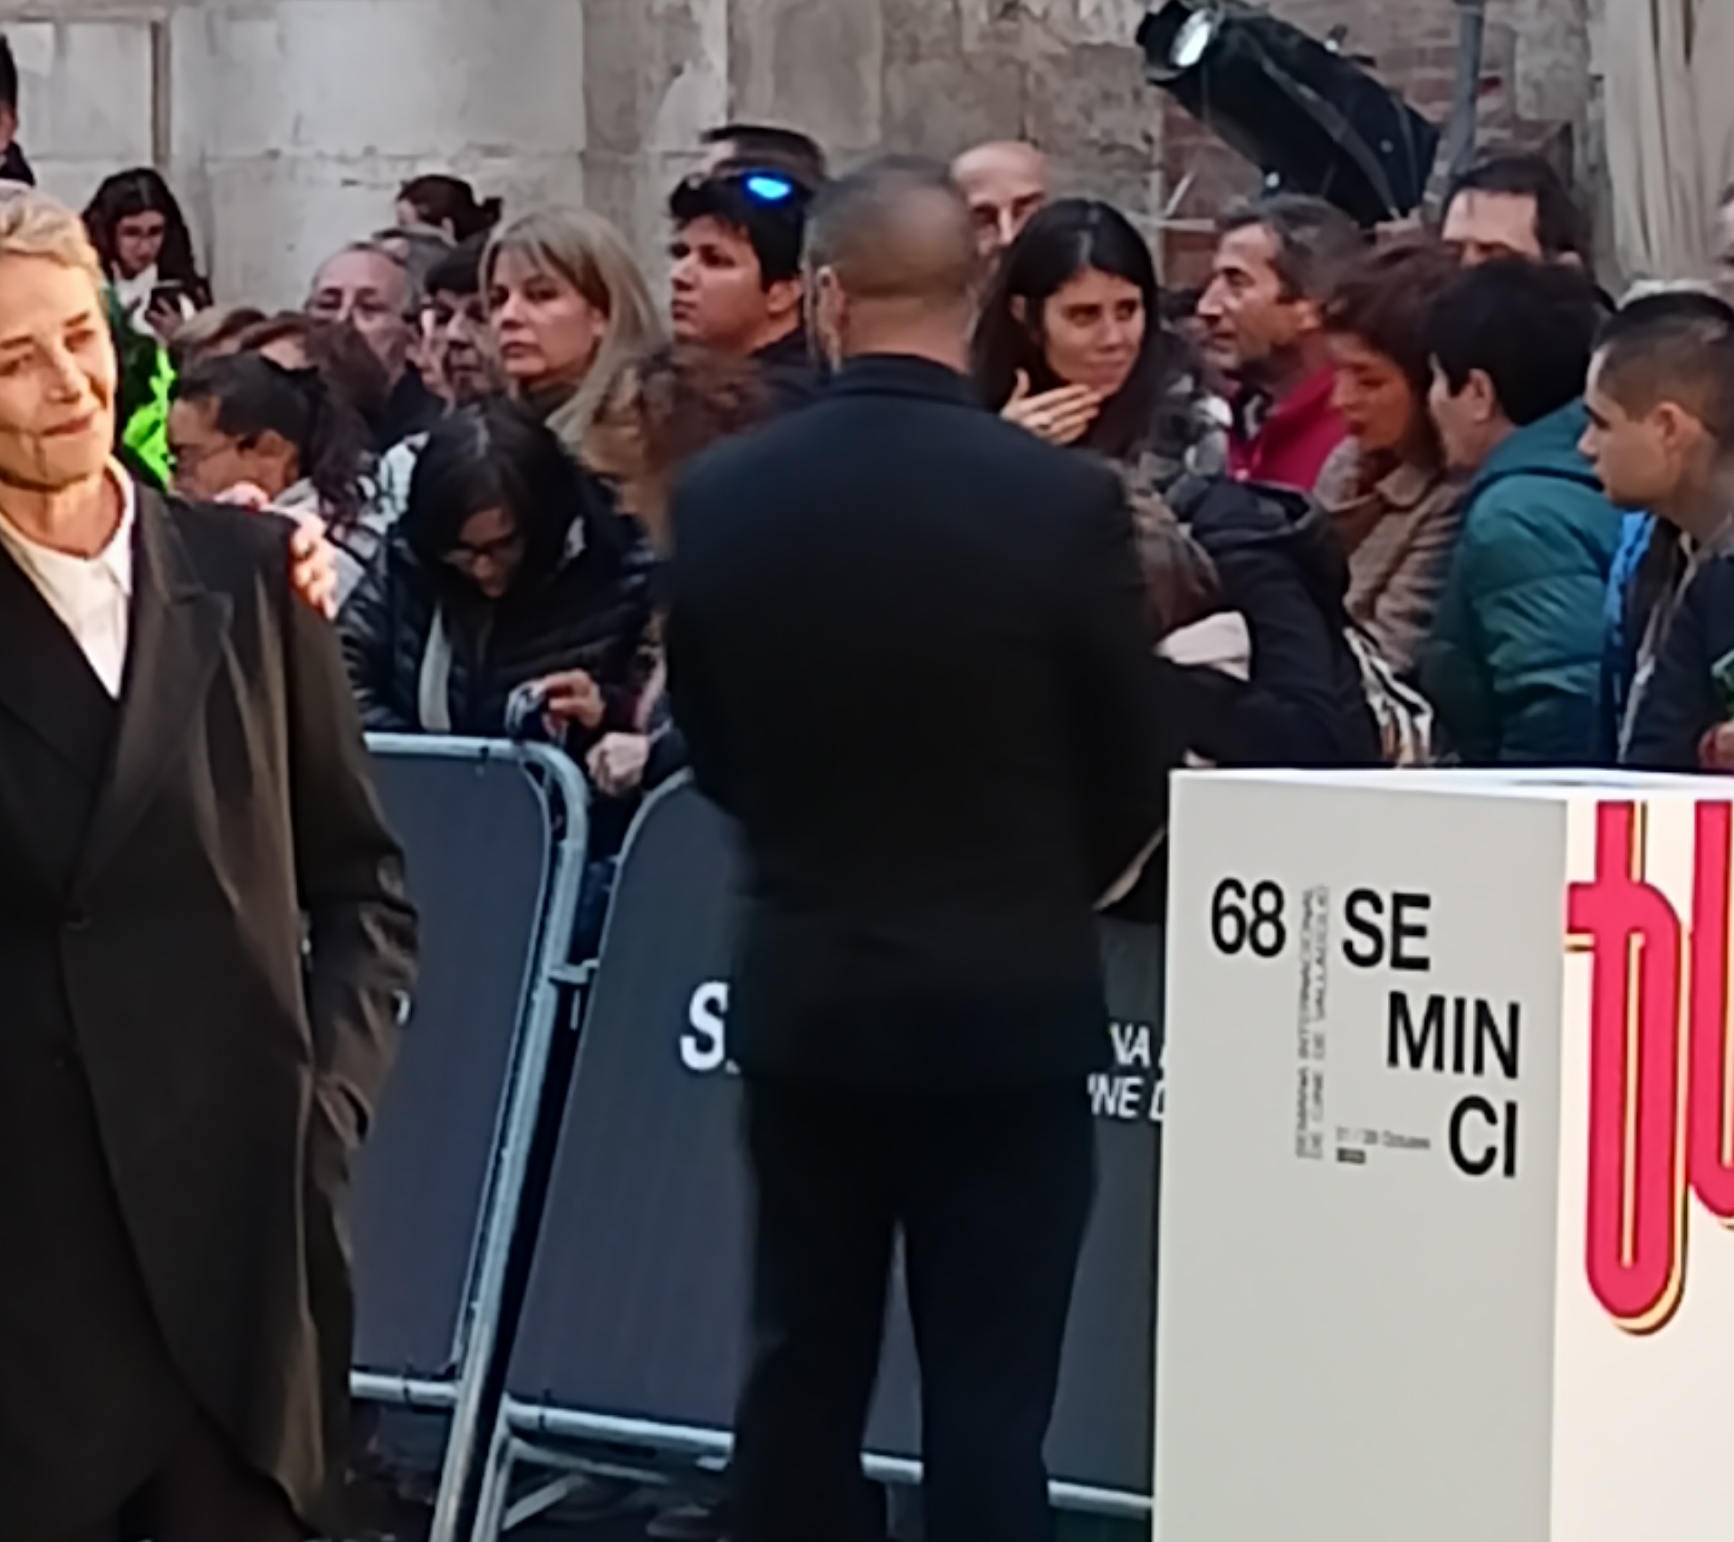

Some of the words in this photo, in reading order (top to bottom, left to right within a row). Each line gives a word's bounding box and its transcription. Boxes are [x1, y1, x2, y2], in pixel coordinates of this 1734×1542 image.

[1210, 877, 1287, 959] 68
[1341, 887, 1432, 972] SE
[1386, 989, 1521, 1080] MIN
[1448, 1094, 1518, 1178] CI
